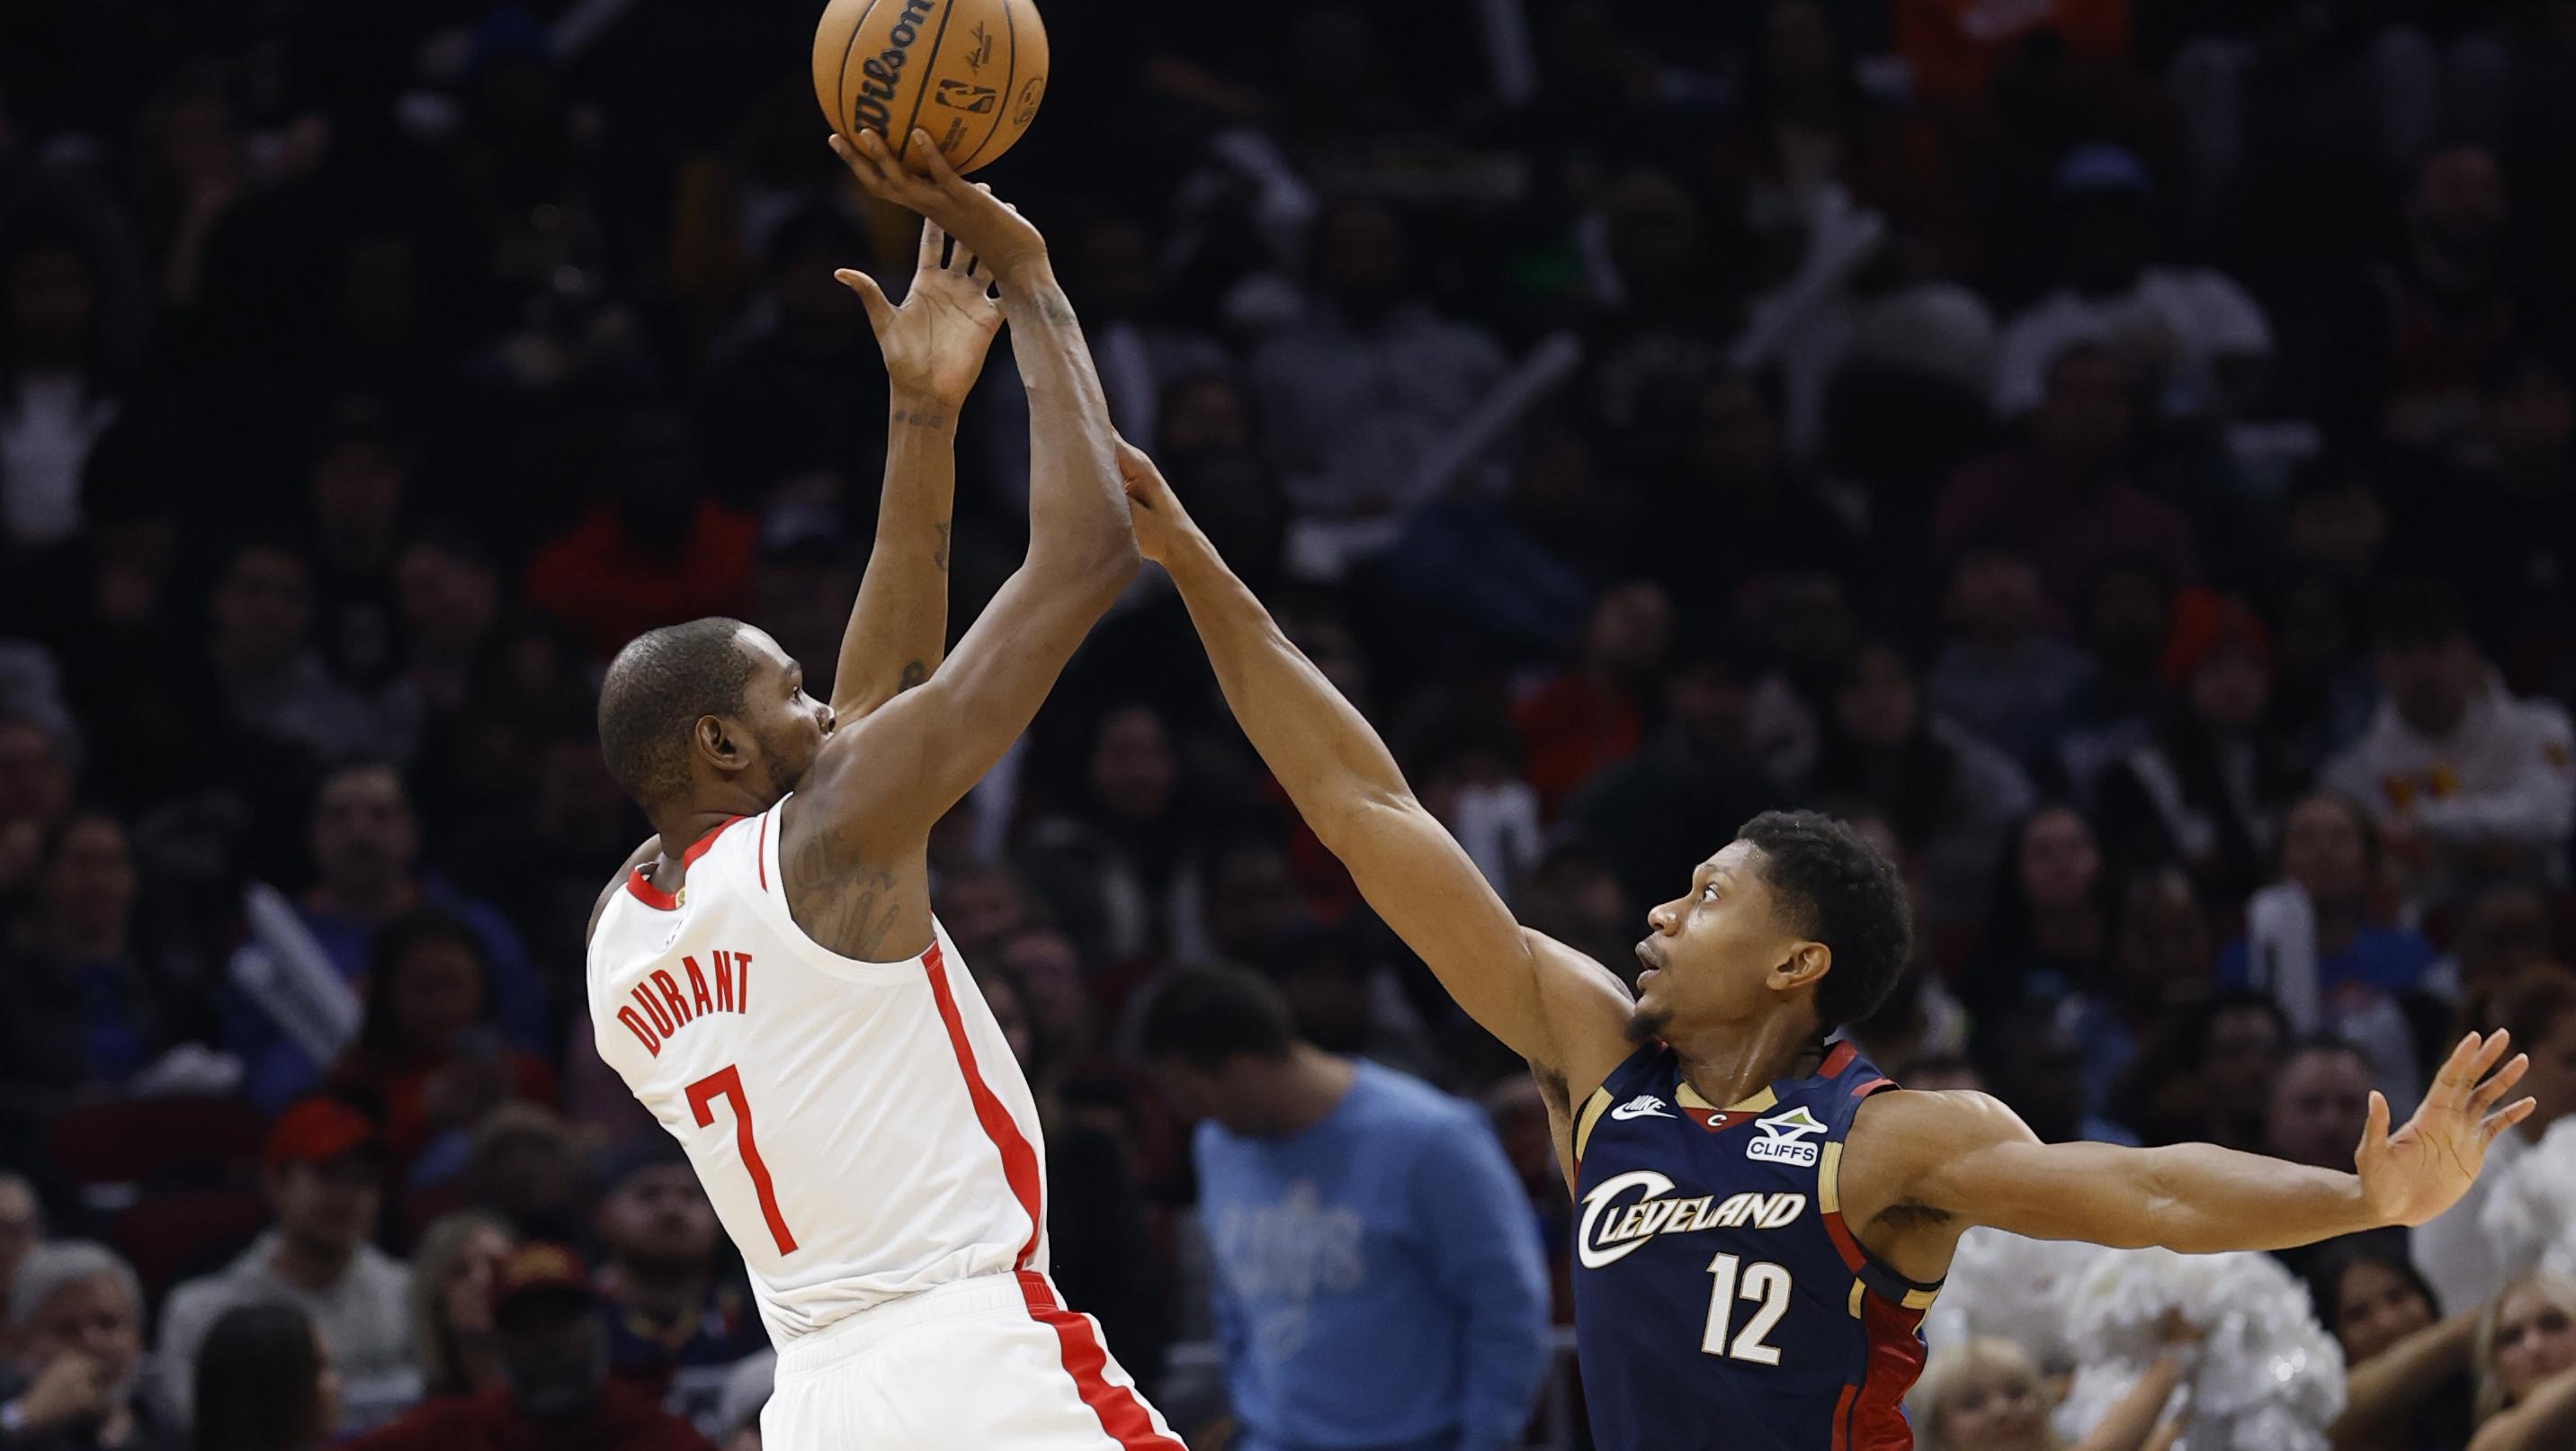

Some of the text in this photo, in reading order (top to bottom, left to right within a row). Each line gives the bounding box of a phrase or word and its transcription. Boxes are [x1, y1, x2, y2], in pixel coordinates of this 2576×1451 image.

[855, 0, 935, 138] Wilson
[617, 950, 752, 1058] DURANT
[684, 1064, 798, 1257] 7
[1750, 1142, 1815, 1161] CLIFFS
[1579, 1170, 1807, 1268] CLEVELAND
[1701, 1251, 1793, 1366] 12
